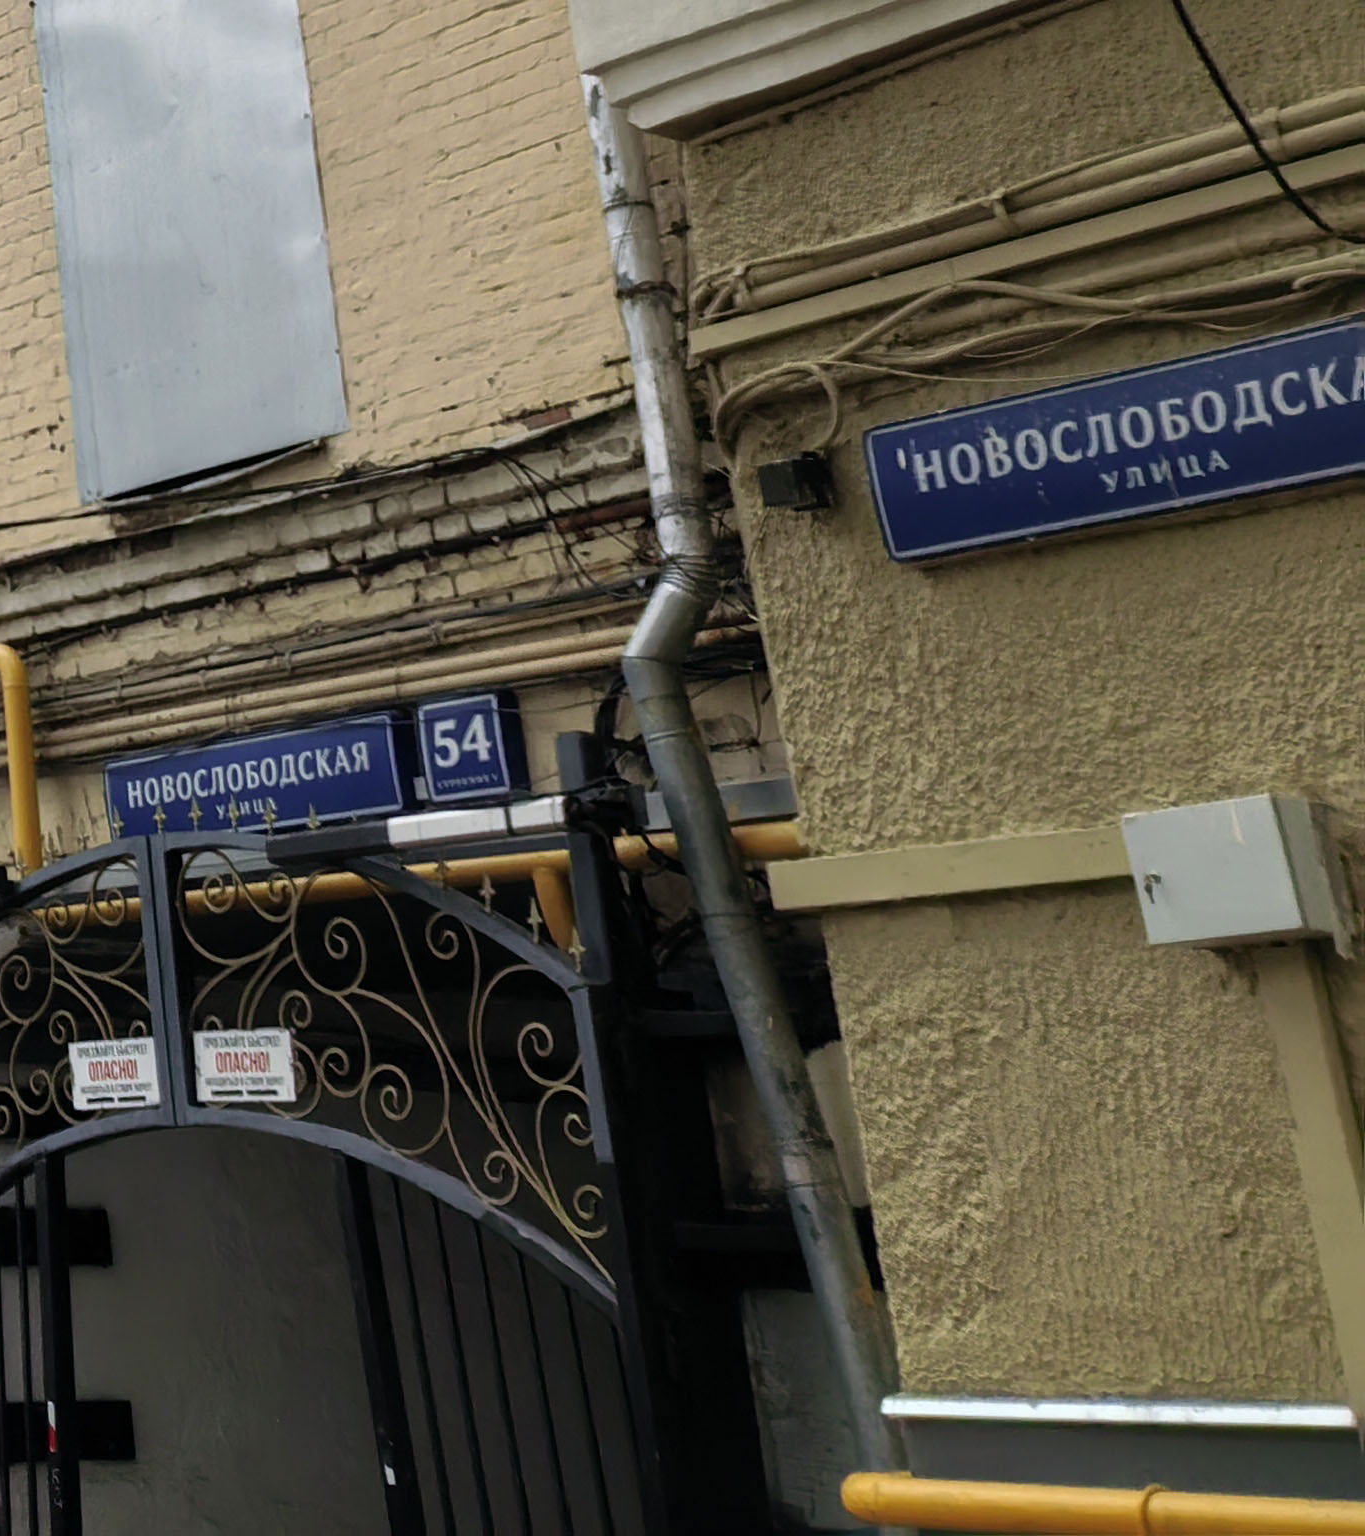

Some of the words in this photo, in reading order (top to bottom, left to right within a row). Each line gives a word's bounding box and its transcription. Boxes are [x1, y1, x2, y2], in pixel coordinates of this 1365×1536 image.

[1099, 449, 1230, 493] УЛИЦА
[434, 714, 493, 768] 54
[127, 742, 370, 808] НОВОСЛОБОДСКАЯ
[216, 797, 278, 819] УИЦА
[88, 1059, 139, 1081] ОПАСНО!
[215, 1051, 270, 1073] ОПАСНО!
